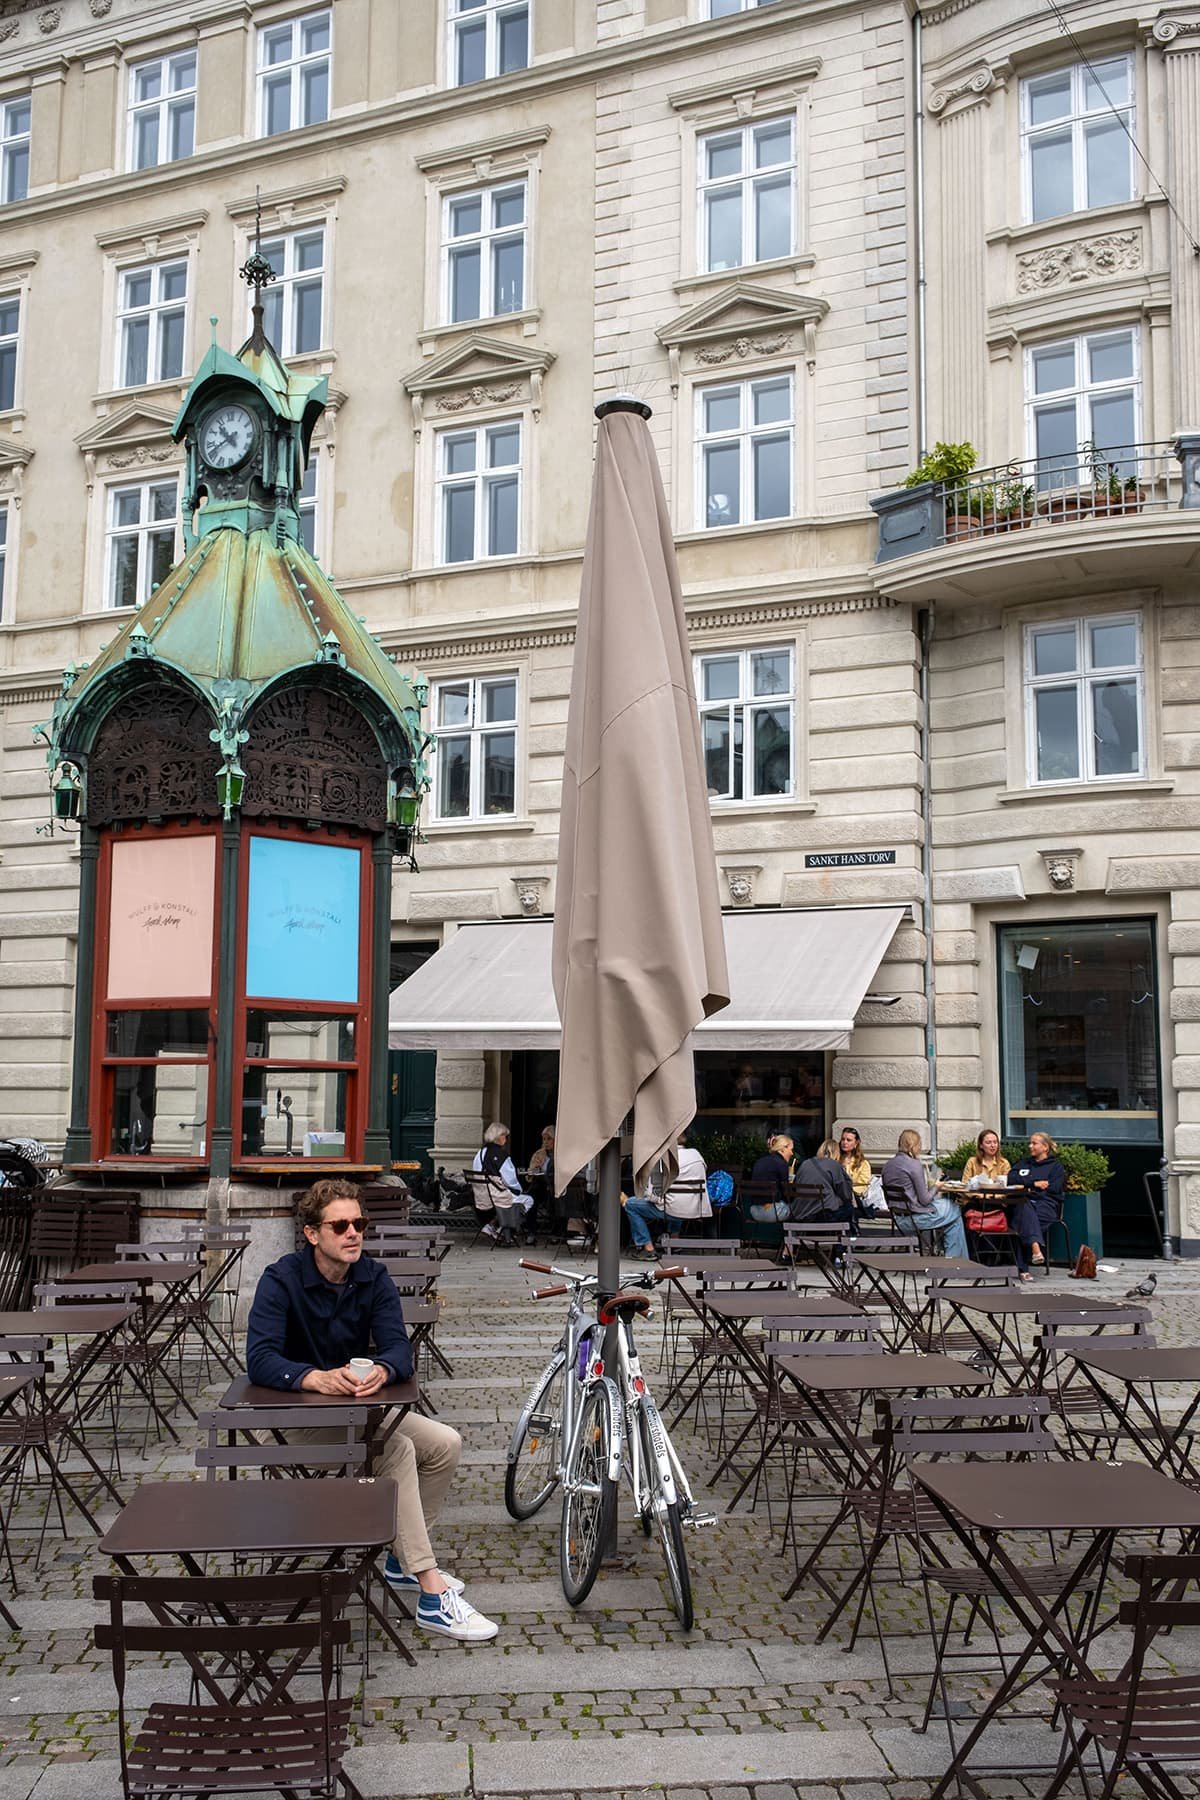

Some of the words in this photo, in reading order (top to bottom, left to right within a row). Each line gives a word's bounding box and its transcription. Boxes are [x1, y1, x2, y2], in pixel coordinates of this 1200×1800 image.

[809, 855, 839, 866] SANKT
[841, 854, 866, 864] HANS
[868, 852, 891, 863] TORV
